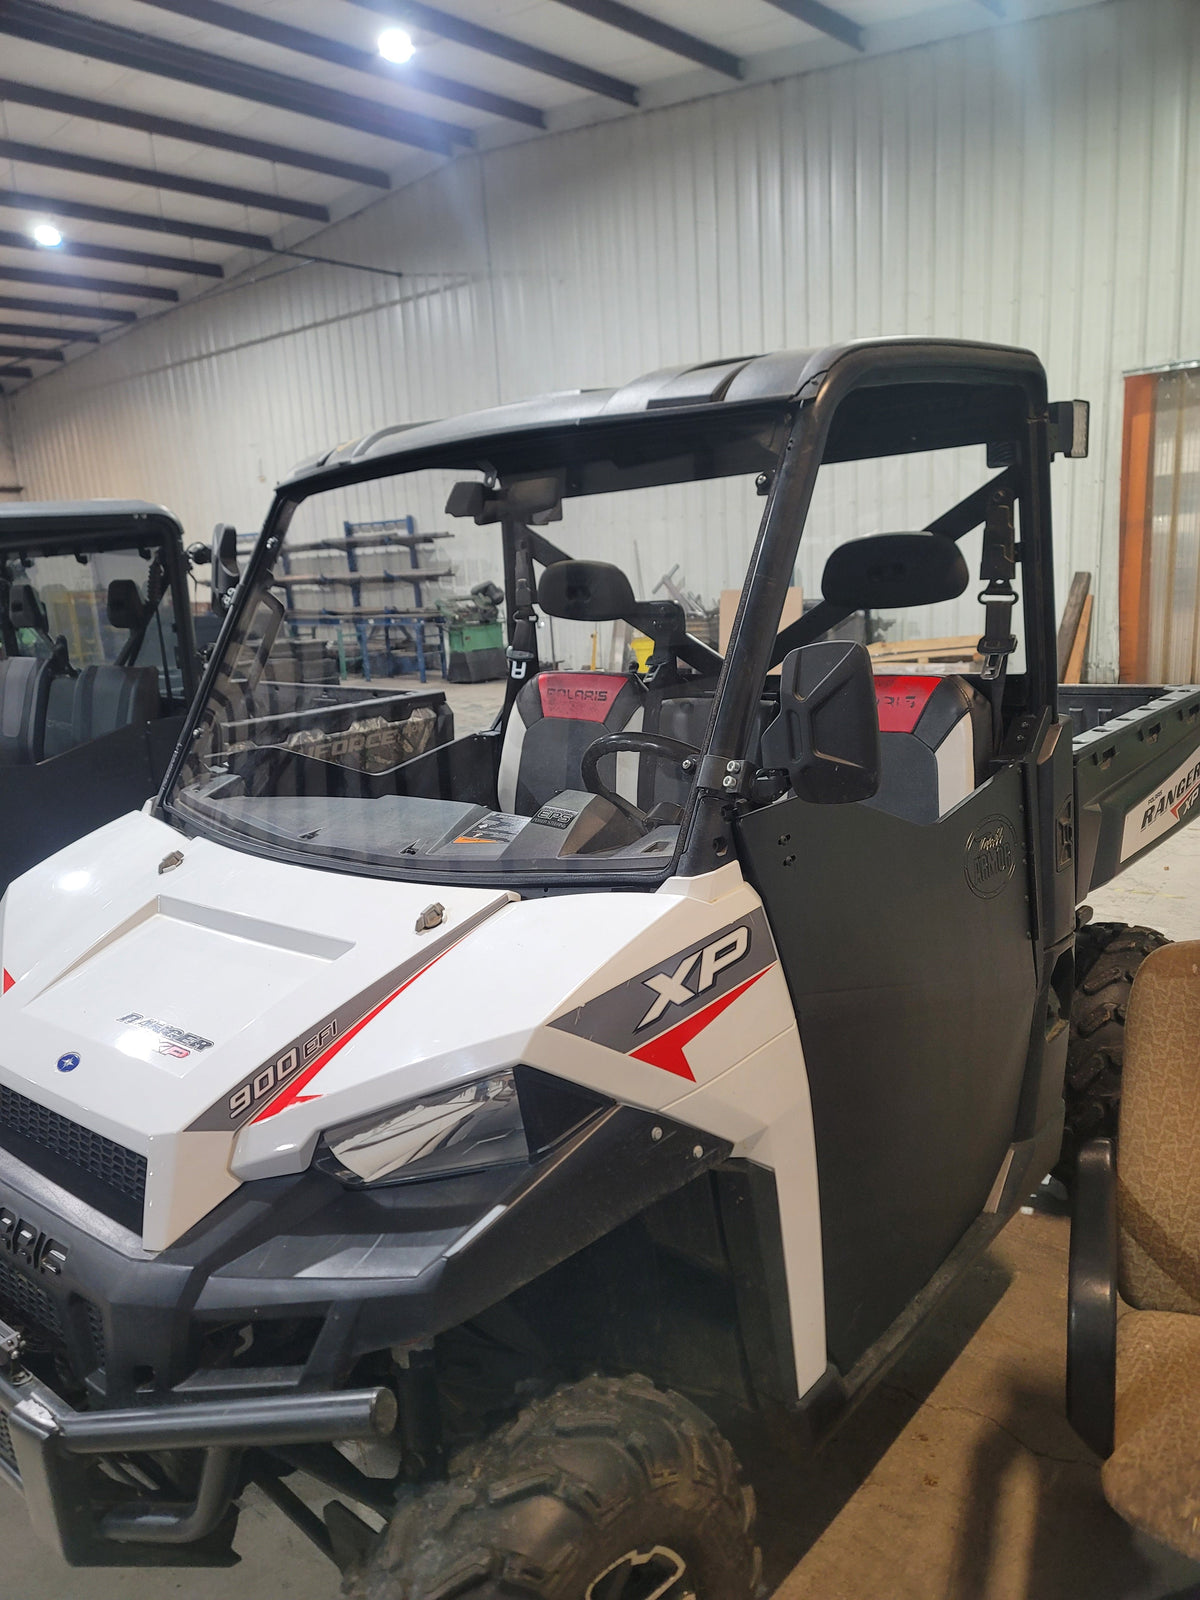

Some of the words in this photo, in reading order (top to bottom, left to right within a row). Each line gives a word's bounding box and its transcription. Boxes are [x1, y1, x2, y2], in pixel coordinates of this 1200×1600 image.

[547, 687, 607, 702] POLARIS
[537, 809, 574, 824] EPS
[1140, 761, 1200, 832] RANGER
[632, 924, 752, 1035] XP
[229, 1046, 299, 1119] 900
[303, 1018, 339, 1060] EFI
